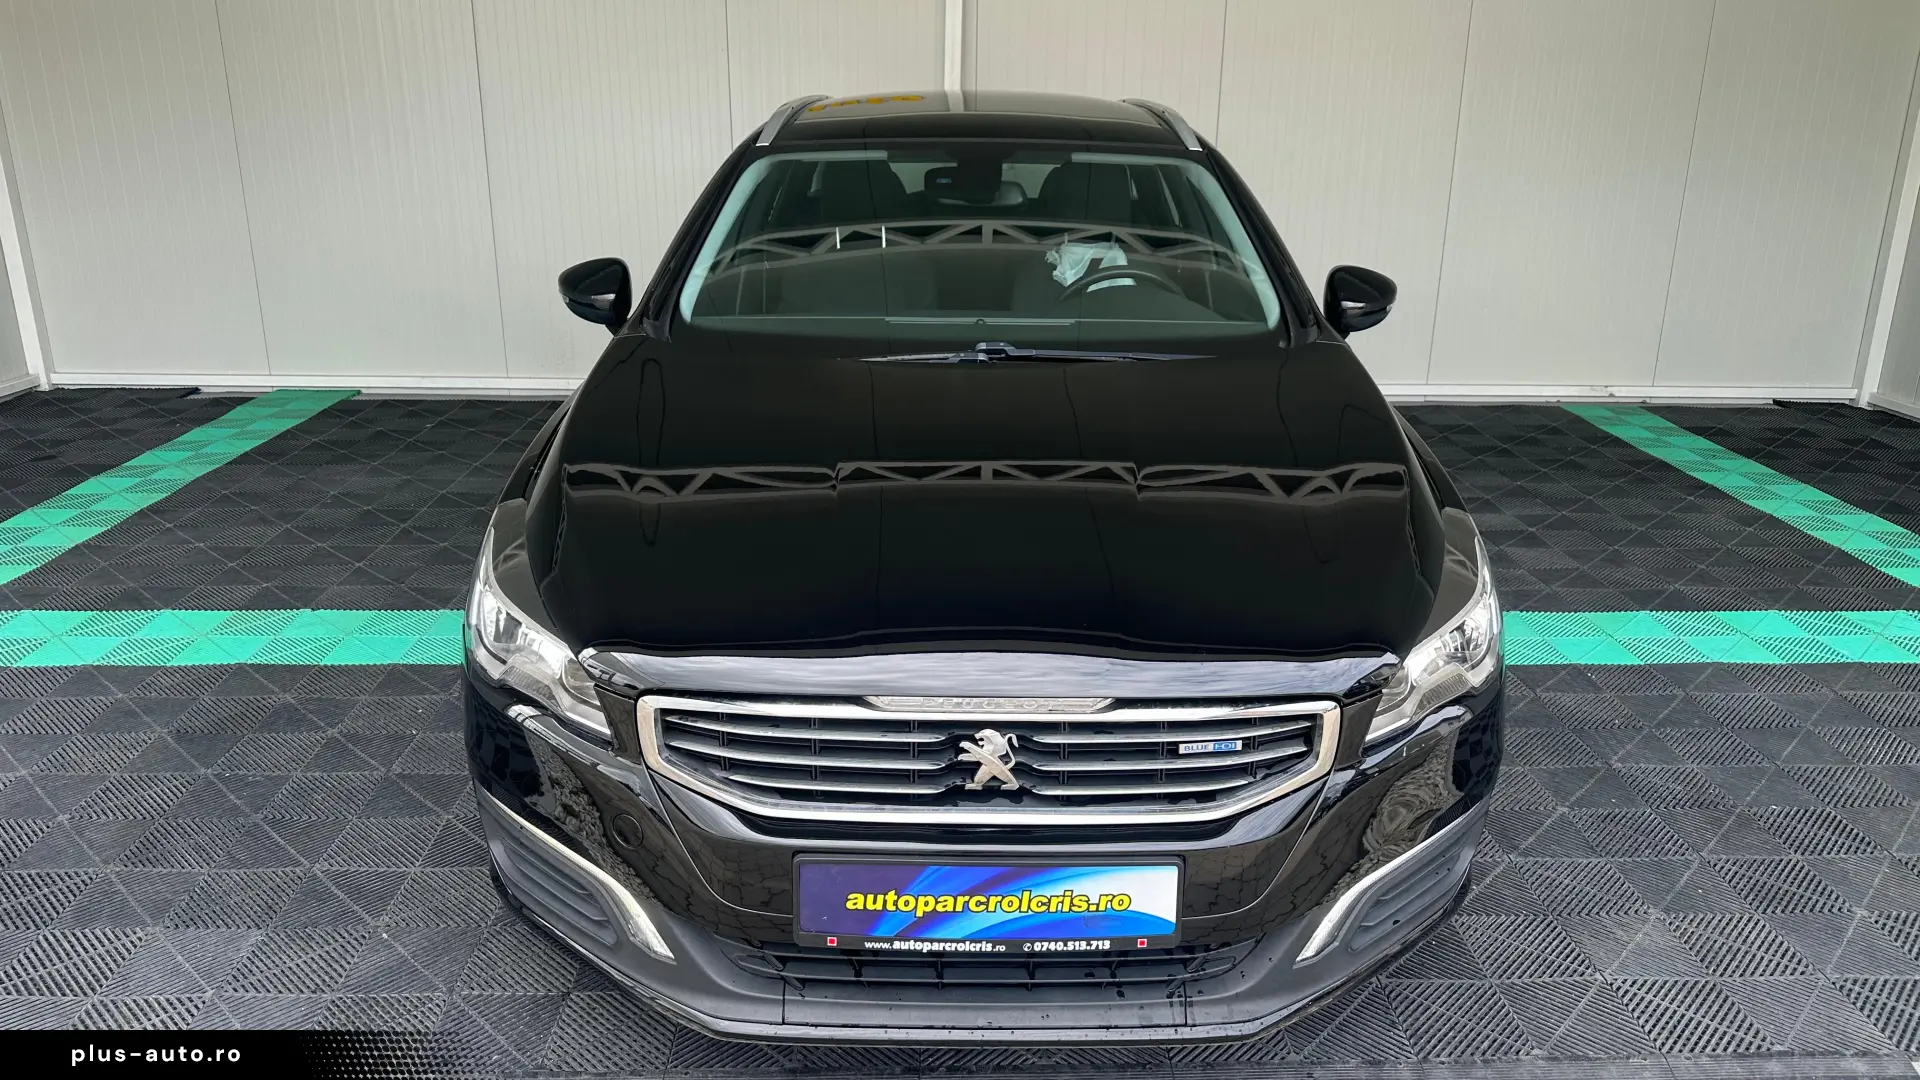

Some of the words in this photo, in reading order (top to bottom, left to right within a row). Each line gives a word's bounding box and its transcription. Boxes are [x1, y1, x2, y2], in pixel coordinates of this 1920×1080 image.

[1184, 744, 1210, 752] BLUE
[1214, 742, 1236, 750] HDI
[845, 889, 1132, 918] autoparcrolcris.ro
[864, 939, 1006, 953] www.autoparcrolcris.ro
[1033, 940, 1111, 951] 0740.513.713
